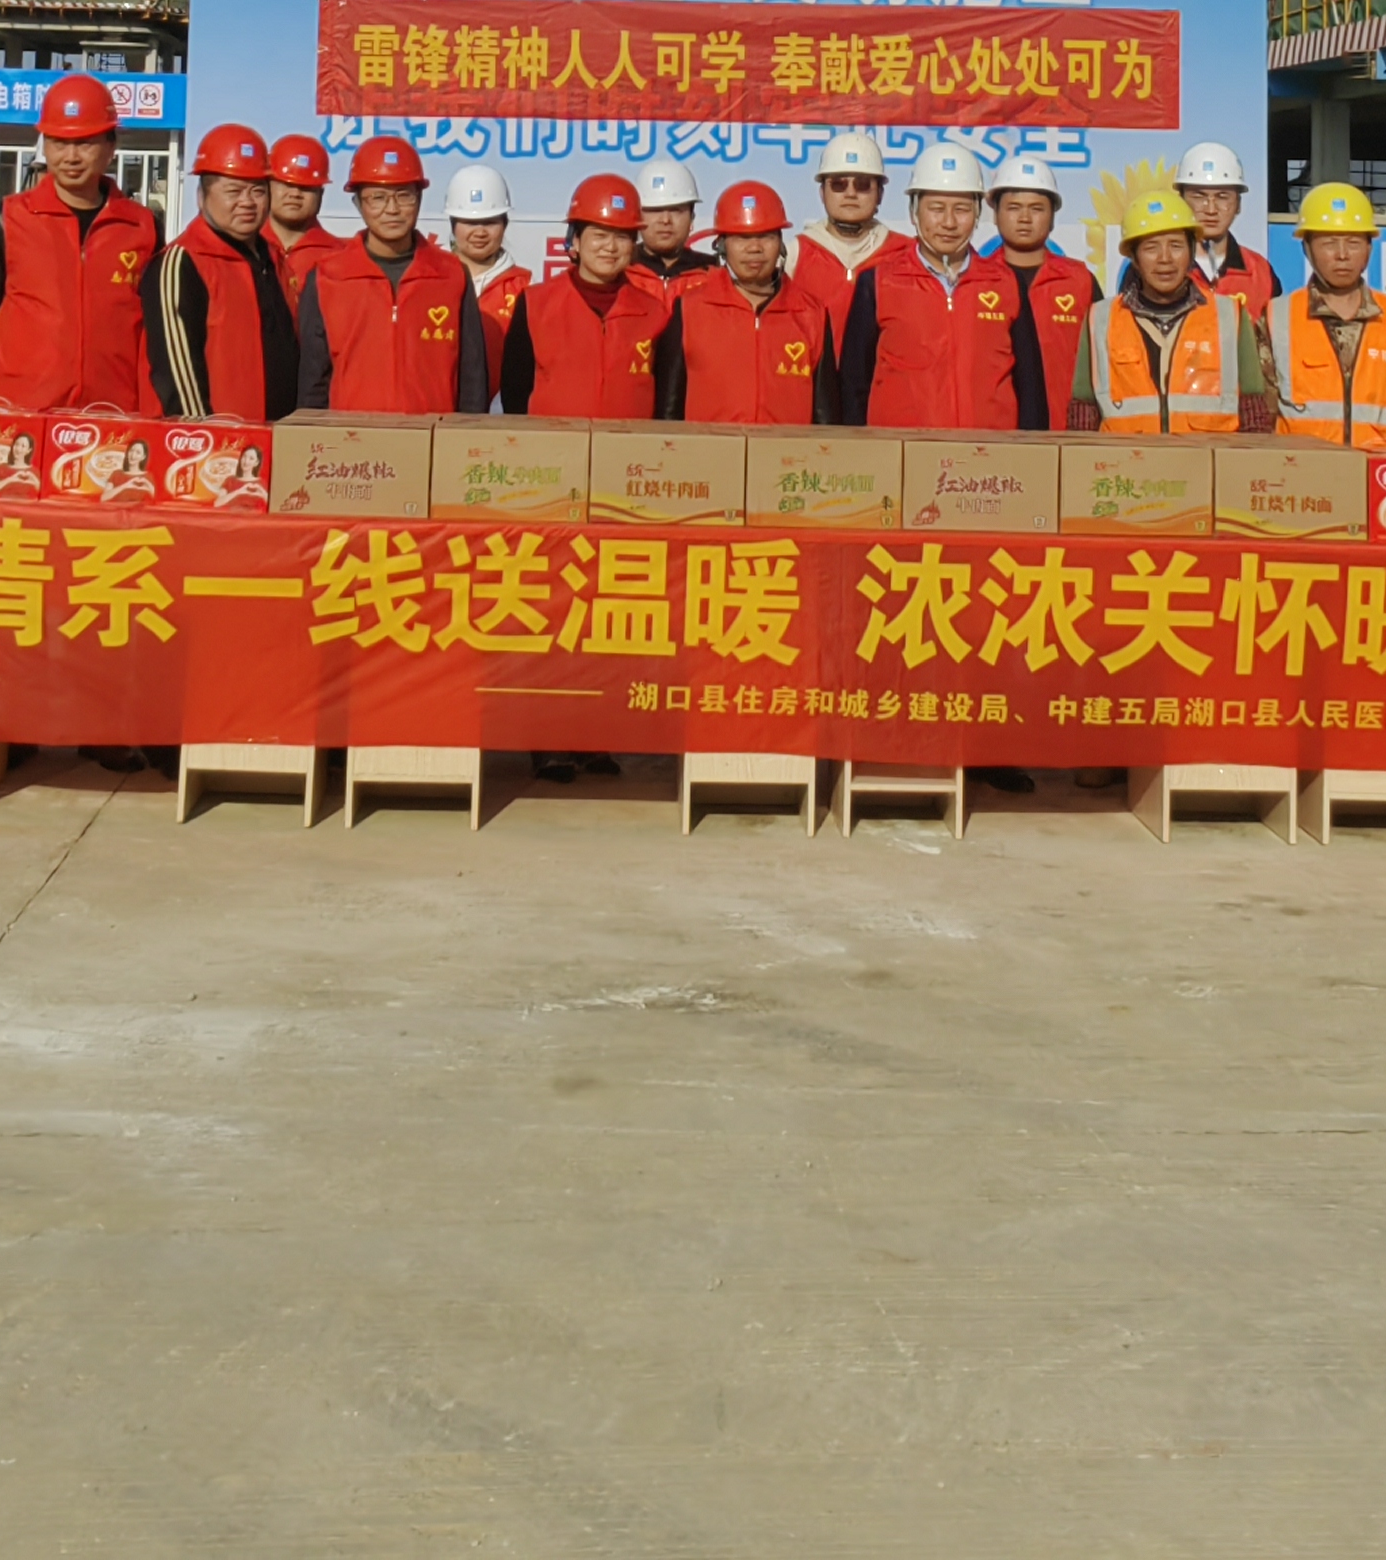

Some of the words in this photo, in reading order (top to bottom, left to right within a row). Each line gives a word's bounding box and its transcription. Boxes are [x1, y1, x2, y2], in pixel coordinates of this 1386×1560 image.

[354, 24, 747, 93] 雷锋精神人人可学
[770, 31, 1154, 100] 奉献爱心处处可为
[626, 479, 710, 500] 红烧牛肉面
[1250, 495, 1332, 514] 红烧牛肉面
